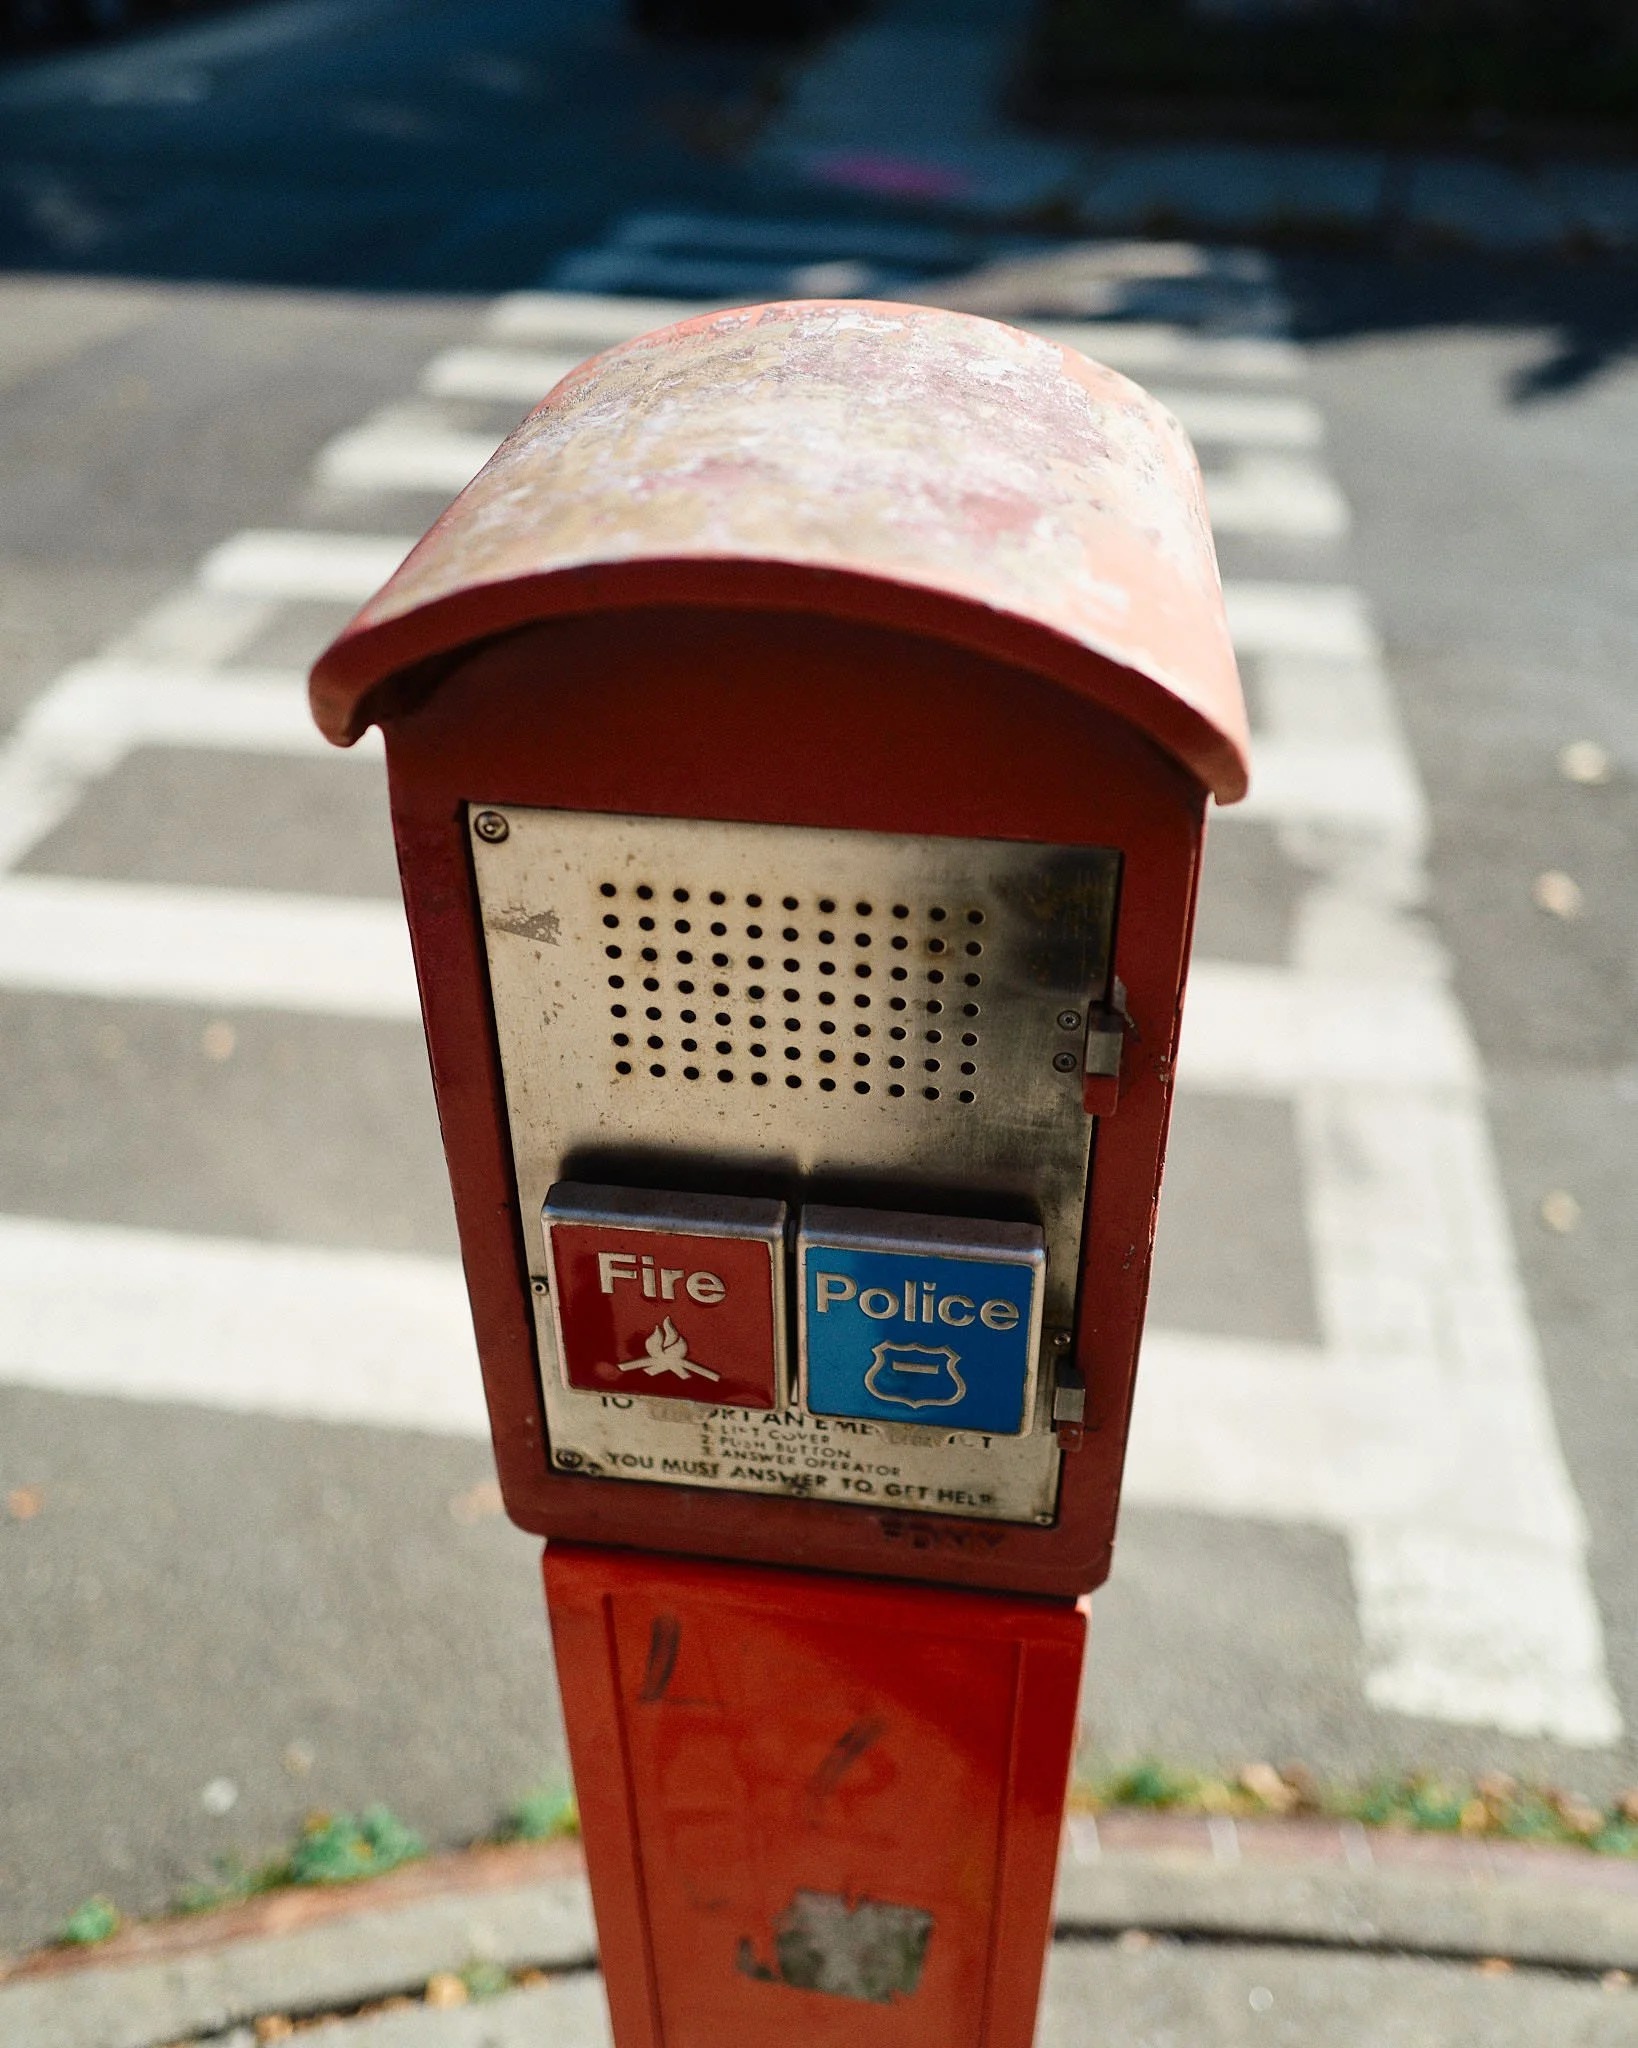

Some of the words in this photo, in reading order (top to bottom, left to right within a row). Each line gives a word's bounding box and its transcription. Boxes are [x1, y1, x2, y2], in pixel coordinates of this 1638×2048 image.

[597, 1251, 727, 1305] Fire
[815, 1271, 1020, 1331] Police
[763, 1411, 804, 1428] AN
[768, 1430, 831, 1444] COVER
[775, 1442, 852, 1459] BUTTON
[722, 1450, 796, 1466] ANSWER
[804, 1457, 902, 1477] OPERATOR
[607, 1451, 654, 1469] YOU
[662, 1458, 720, 1477] MUST
[730, 1465, 829, 1487] ANSWER
[842, 1478, 874, 1494] TO
[885, 1483, 933, 1500] GET
[937, 1488, 995, 1506] HELP
